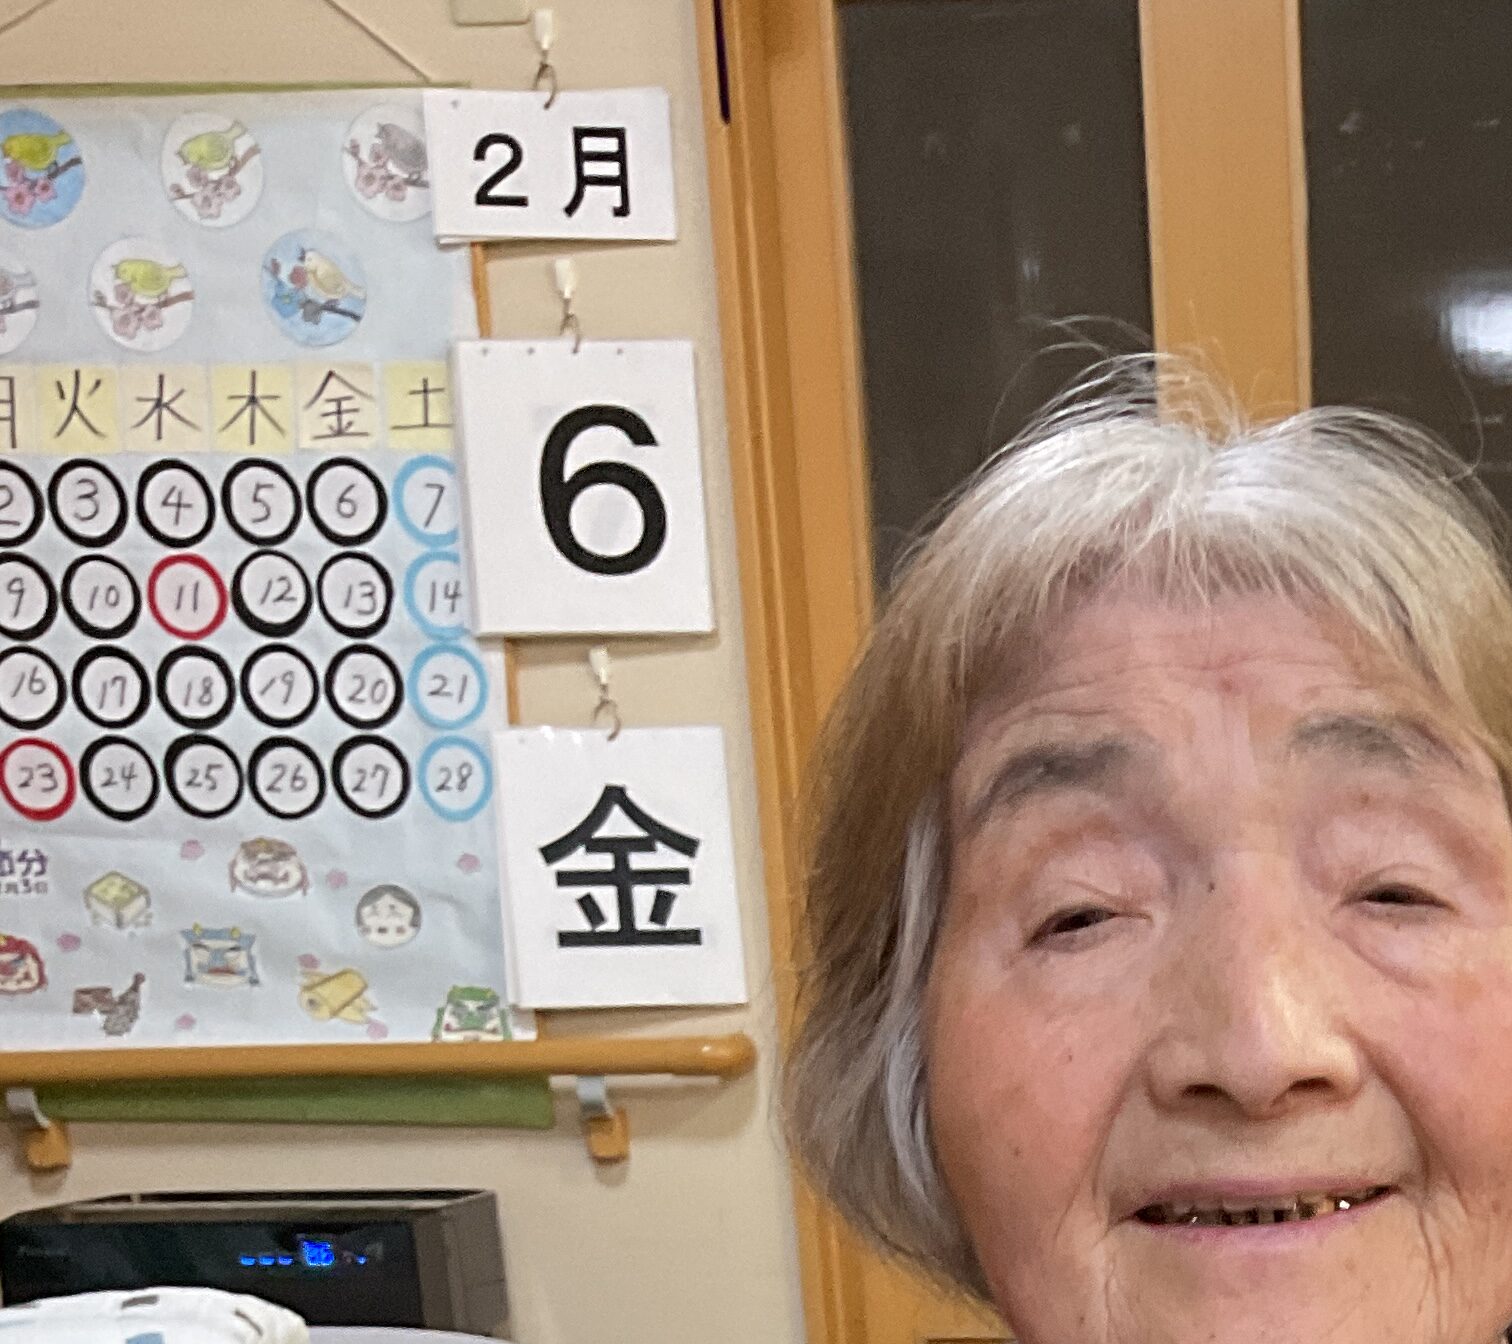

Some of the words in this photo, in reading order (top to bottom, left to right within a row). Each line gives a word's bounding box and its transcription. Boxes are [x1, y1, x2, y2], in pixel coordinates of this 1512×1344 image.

[54, 369, 107, 438] 火
[131, 373, 201, 440] 水
[219, 370, 285, 445] 木
[303, 370, 375, 440] 金
[391, 377, 454, 430] 土
[74, 478, 99, 521] 3
[161, 485, 193, 526] 4
[252, 481, 275, 524] 5
[336, 483, 357, 518] 6
[425, 483, 445, 530] 7
[539, 403, 668, 577] 6
[7, 576, 25, 619] 9
[89, 585, 121, 611] 10
[175, 580, 199, 613] 11
[260, 576, 297, 605] 12
[343, 581, 377, 615] 13
[429, 579, 463, 613] 14
[11, 666, 46, 698] 16
[98, 676, 127, 709] 17
[184, 676, 213, 707] 18
[257, 670, 296, 704] 19
[348, 673, 389, 705] 20
[427, 674, 468, 703] 21
[18, 763, 59, 793] 23
[101, 762, 138, 791] 24
[185, 763, 224, 791] 25
[266, 763, 308, 793] 26
[352, 764, 391, 798] 27
[434, 761, 473, 793] 28
[538, 784, 703, 948] 金
